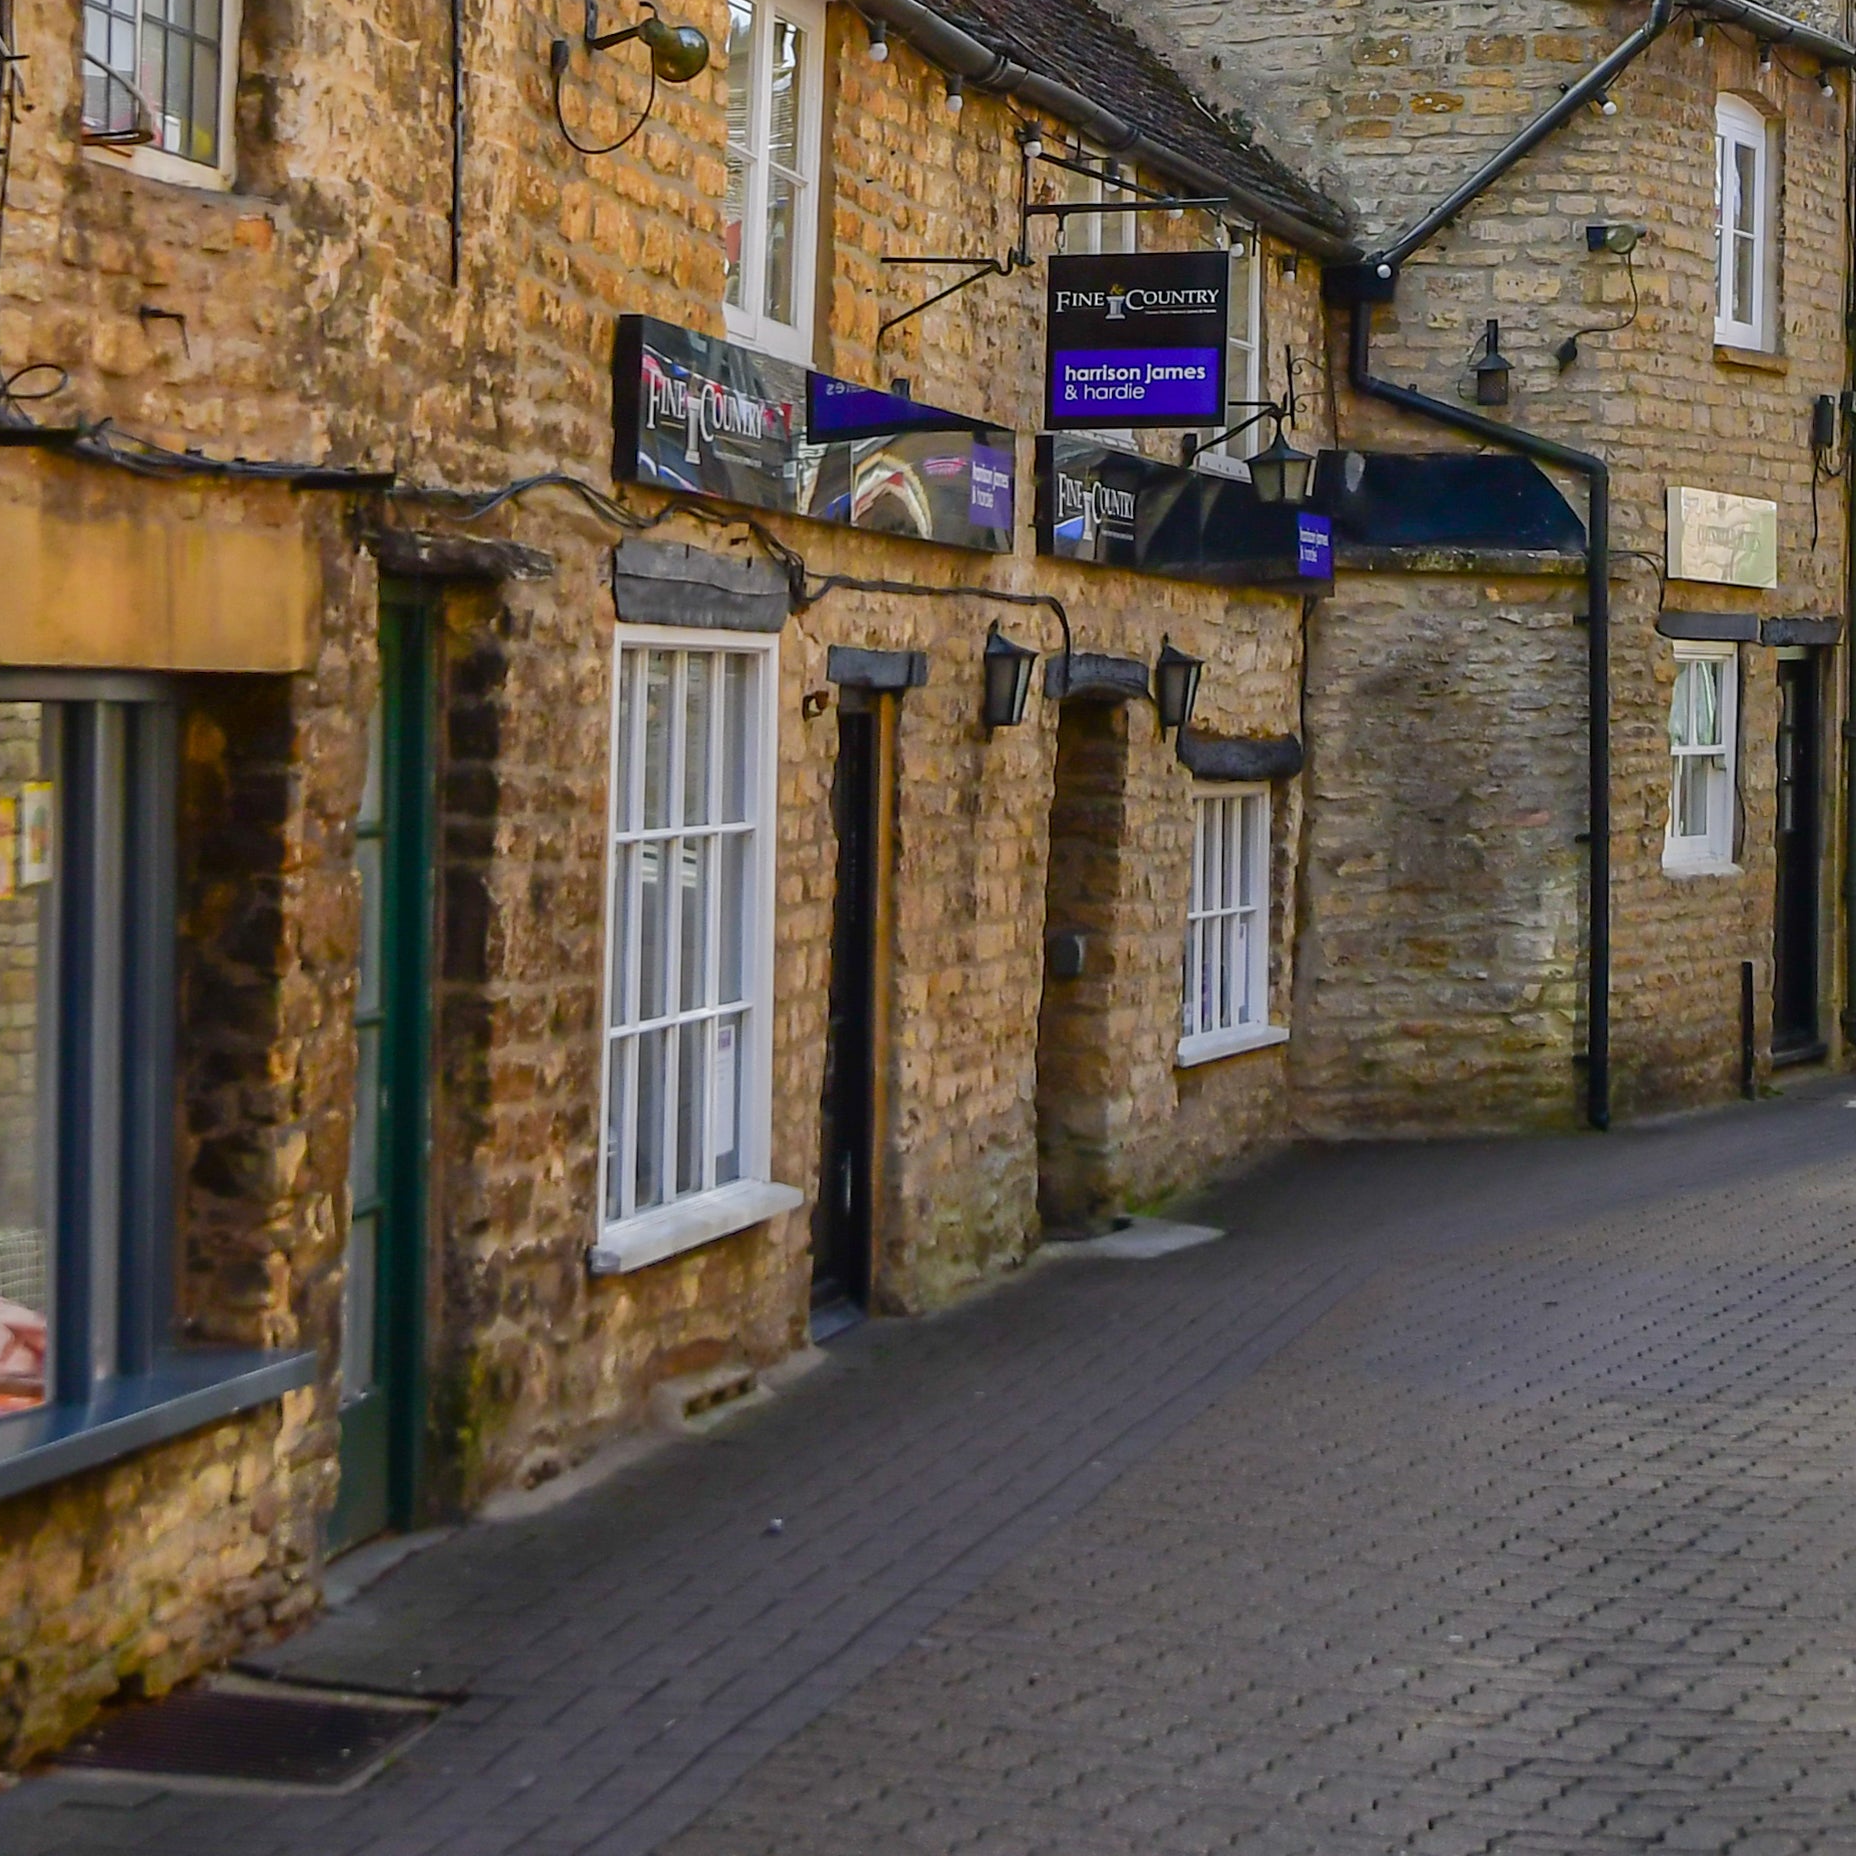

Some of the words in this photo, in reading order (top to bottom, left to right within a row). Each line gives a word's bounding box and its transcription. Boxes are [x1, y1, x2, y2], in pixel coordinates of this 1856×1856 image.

[1055, 290, 1105, 313] FINE
[1125, 288, 1220, 311] COUNTRY
[1064, 364, 1141, 382] harrison
[1144, 362, 1207, 385] james
[1064, 383, 1079, 401] &
[1083, 382, 1146, 400] hardie
[645, 367, 687, 430] FINE
[699, 383, 766, 443] COUNTRY
[1057, 472, 1084, 518] FINE
[1091, 480, 1136, 525] COUNTRY
